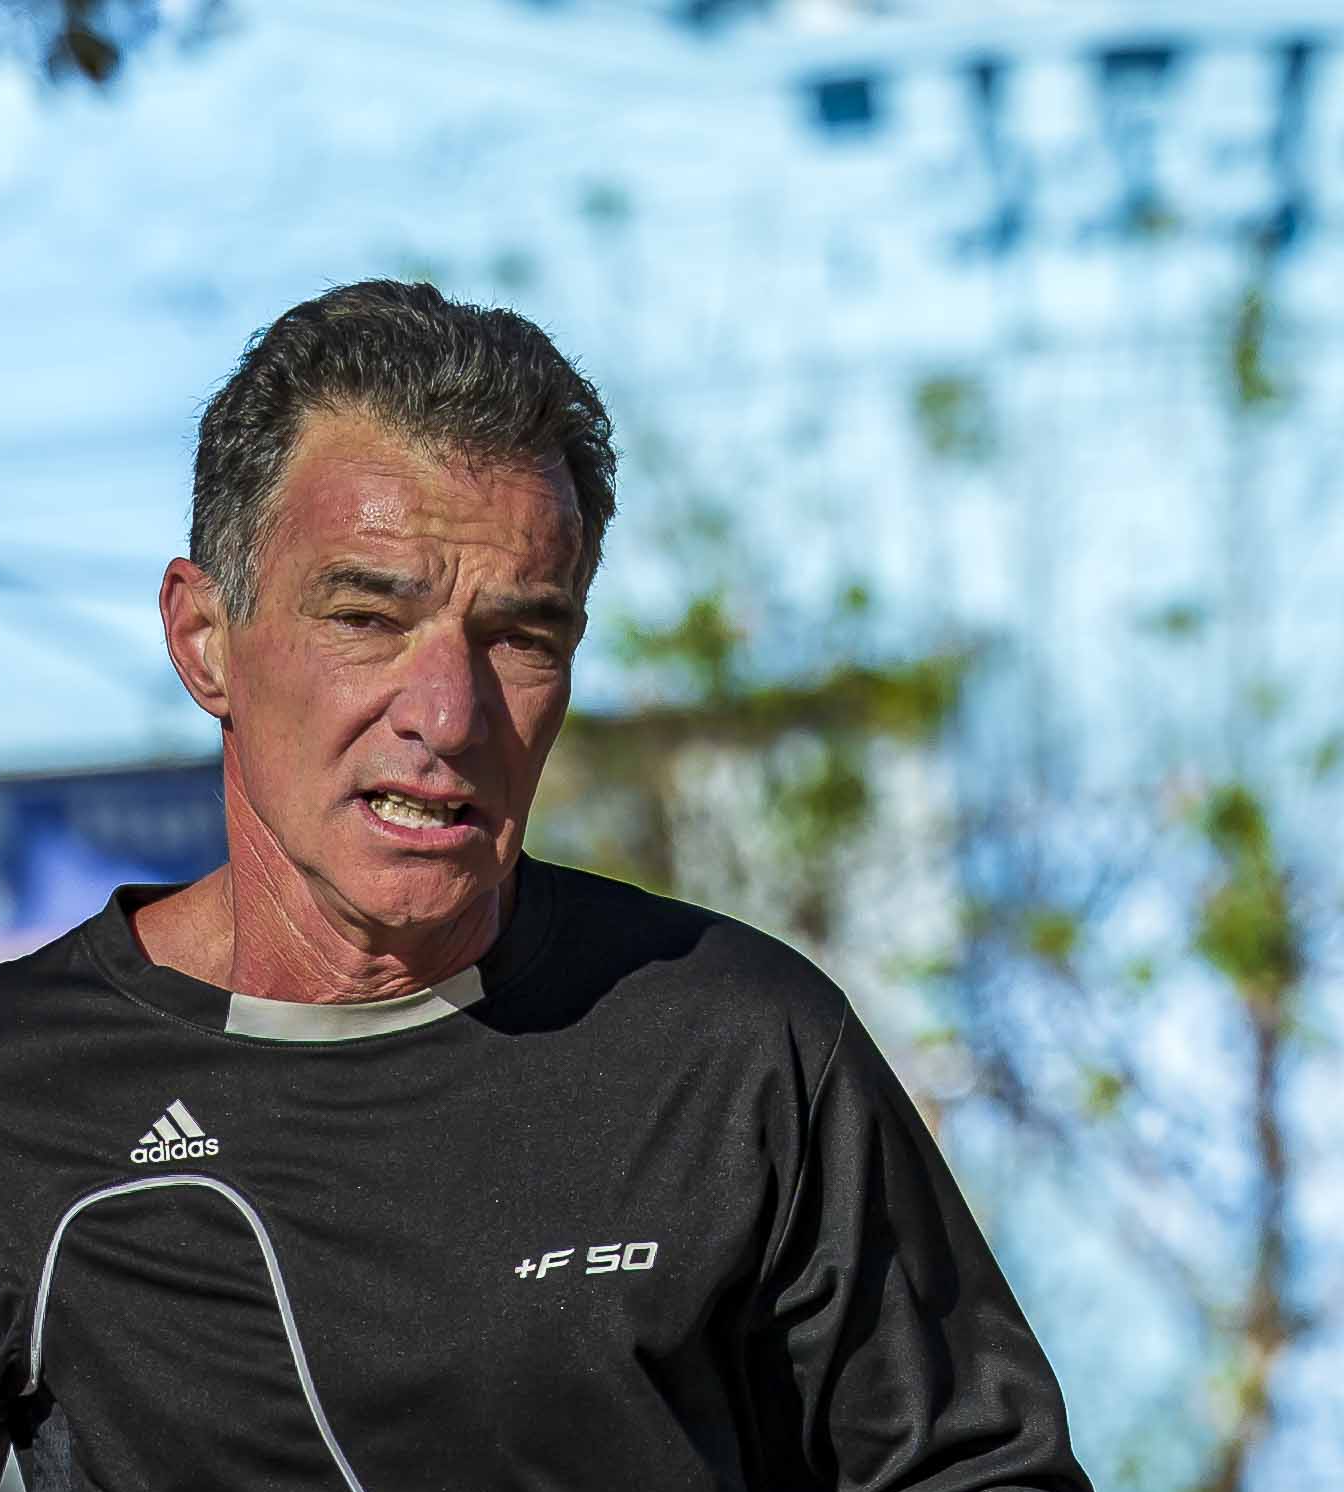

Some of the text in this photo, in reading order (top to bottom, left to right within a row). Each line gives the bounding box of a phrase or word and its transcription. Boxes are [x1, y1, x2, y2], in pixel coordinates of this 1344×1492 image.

[130, 1138, 219, 1163] adidas
[514, 1242, 659, 1279] +F 50
